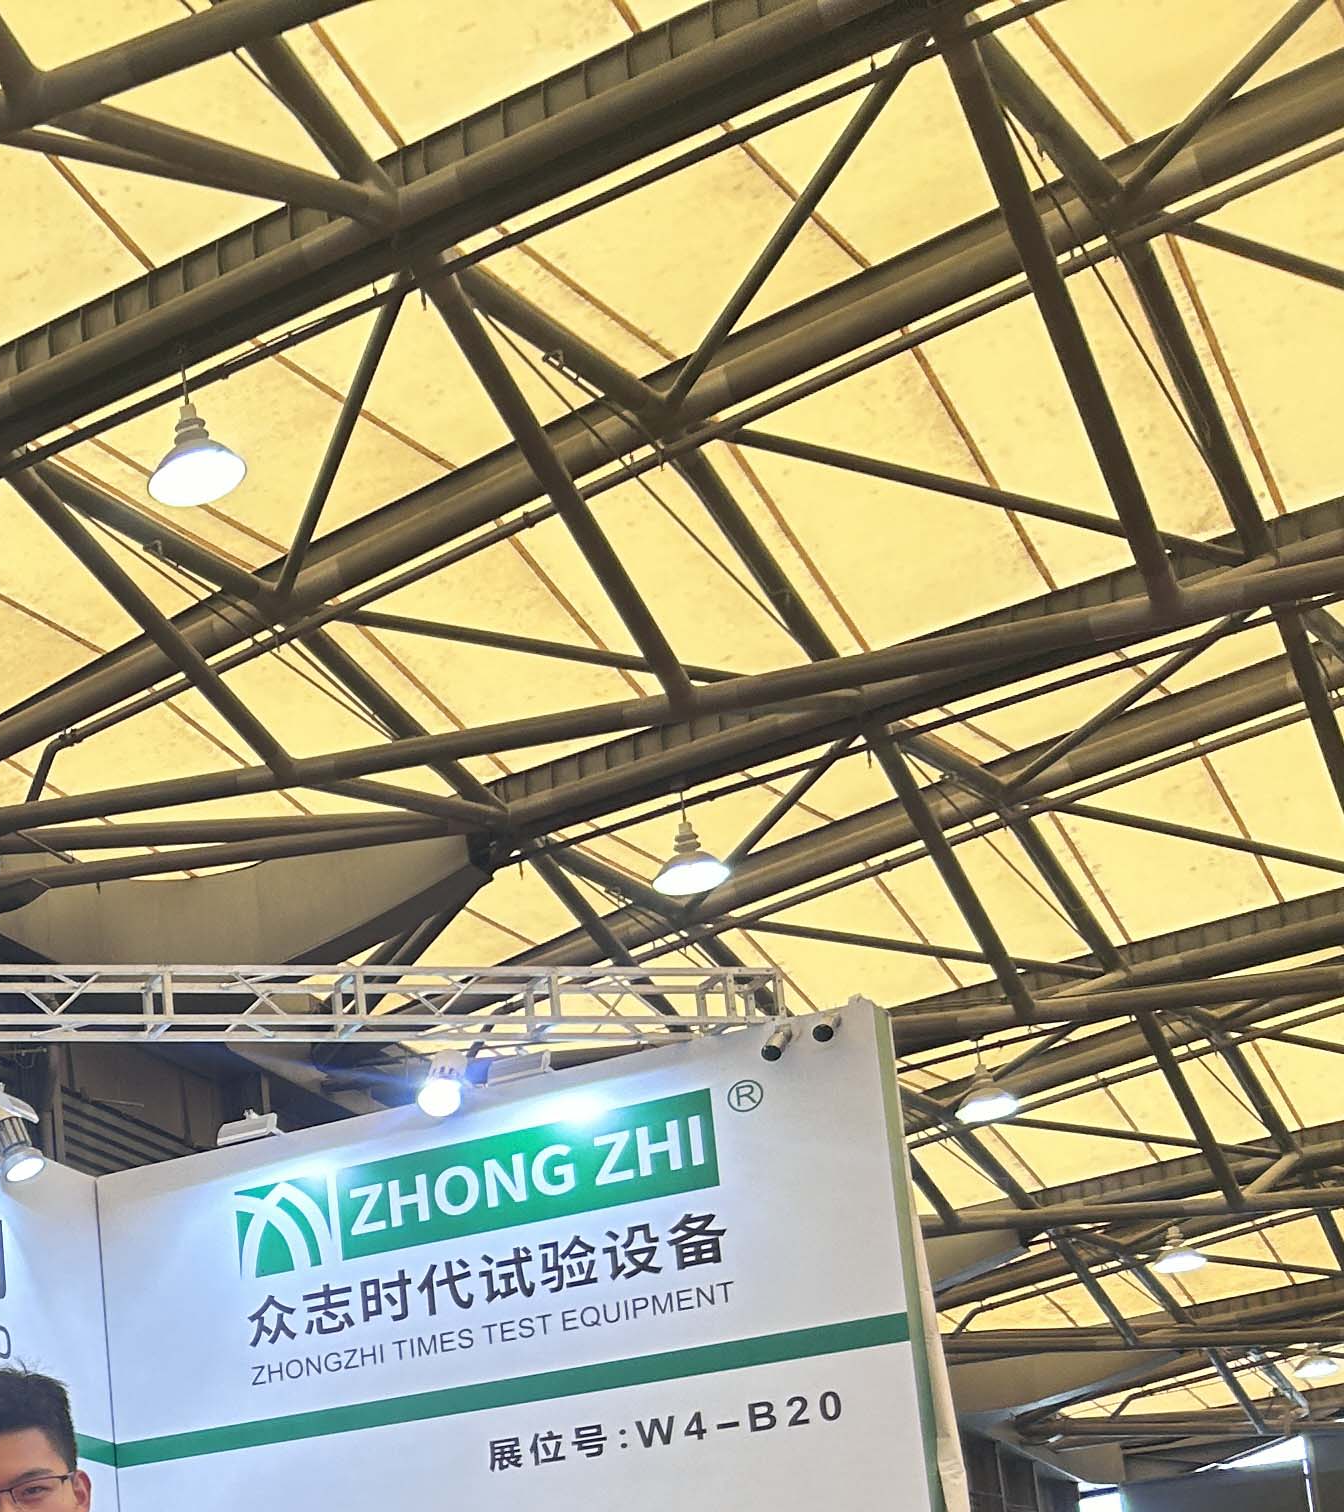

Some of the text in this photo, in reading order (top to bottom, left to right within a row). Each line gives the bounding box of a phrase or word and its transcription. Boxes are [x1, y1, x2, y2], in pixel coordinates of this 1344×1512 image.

[348, 1145, 575, 1236] ZHONG
[595, 1115, 705, 1186] ZHI
[247, 1213, 728, 1349] 众志时代试验设备
[250, 1280, 735, 1387] ZHONGZHI TIMES TEST EQUIPMENT
